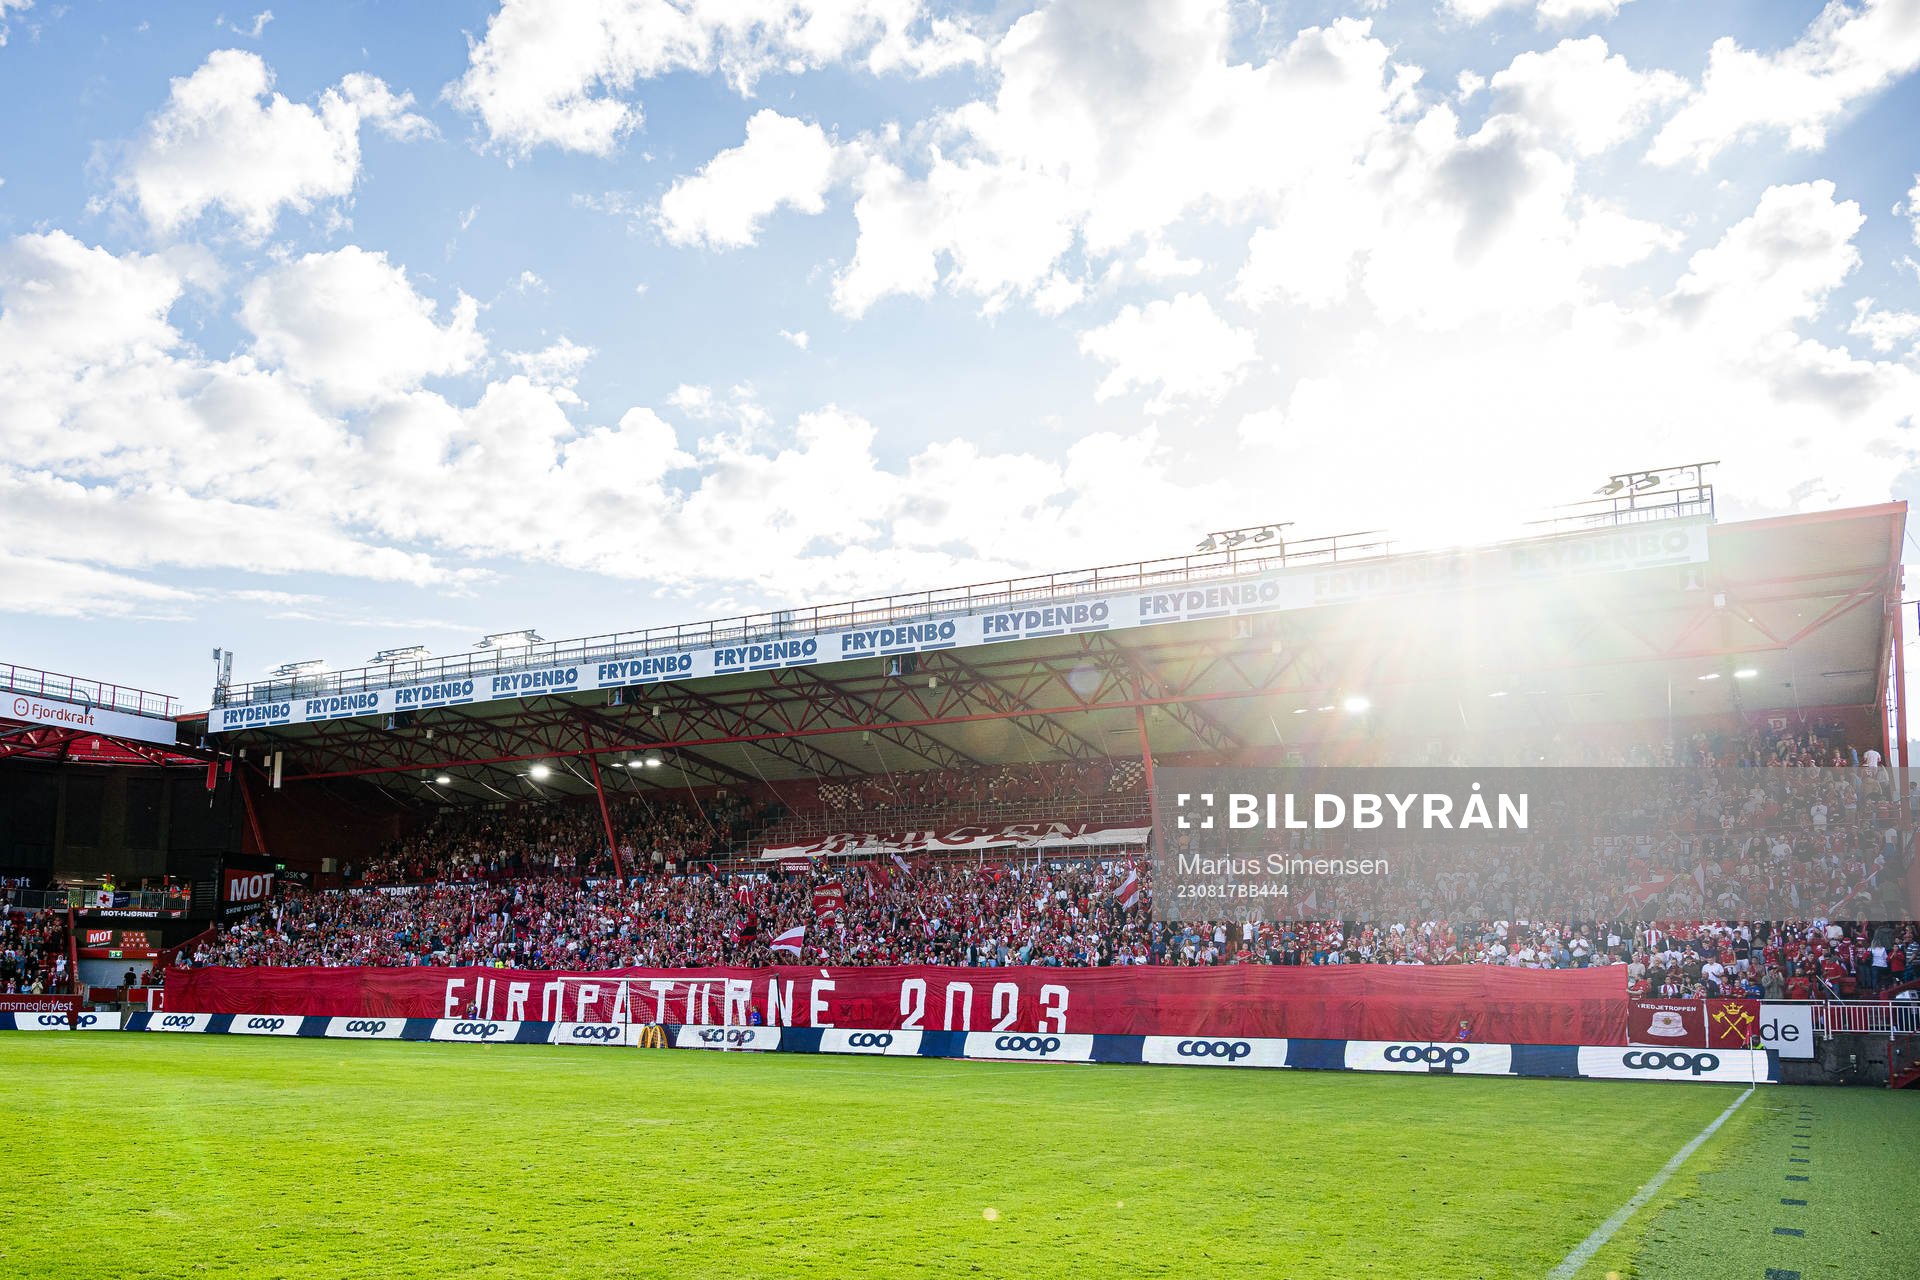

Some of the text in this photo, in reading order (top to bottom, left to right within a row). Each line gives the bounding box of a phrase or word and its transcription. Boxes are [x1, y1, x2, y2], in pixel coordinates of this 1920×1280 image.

[1139, 580, 1280, 616] FRYDENBØ
[983, 600, 1109, 634] FRYDENBØ
[841, 620, 956, 651] FRYDENBØ
[714, 636, 818, 666] FRYDENBØ
[598, 652, 692, 680] FRYDENBØ
[492, 666, 578, 692] FRYDENBØ
[395, 678, 474, 704] FRYDENBØ
[32, 703, 95, 726] Fjordkraft
[223, 702, 291, 724] FRYDENBØ
[306, 692, 379, 715] FRYDENBØ
[230, 873, 274, 901] MOT
[100, 910, 158, 918] MOT-HJØRNET
[90, 930, 112, 943] MOT
[900, 978, 1070, 1033] 2023
[162, 1015, 195, 1027] coop
[247, 1017, 285, 1030] coop
[345, 1020, 387, 1035] coop
[453, 1022, 498, 1037] coop
[572, 1025, 620, 1042] coop
[701, 1028, 755, 1046] coop
[995, 1035, 1061, 1056] coop
[1176, 1040, 1251, 1062] coop
[1383, 1045, 1470, 1072] coop
[1622, 1051, 1720, 1076] coop
